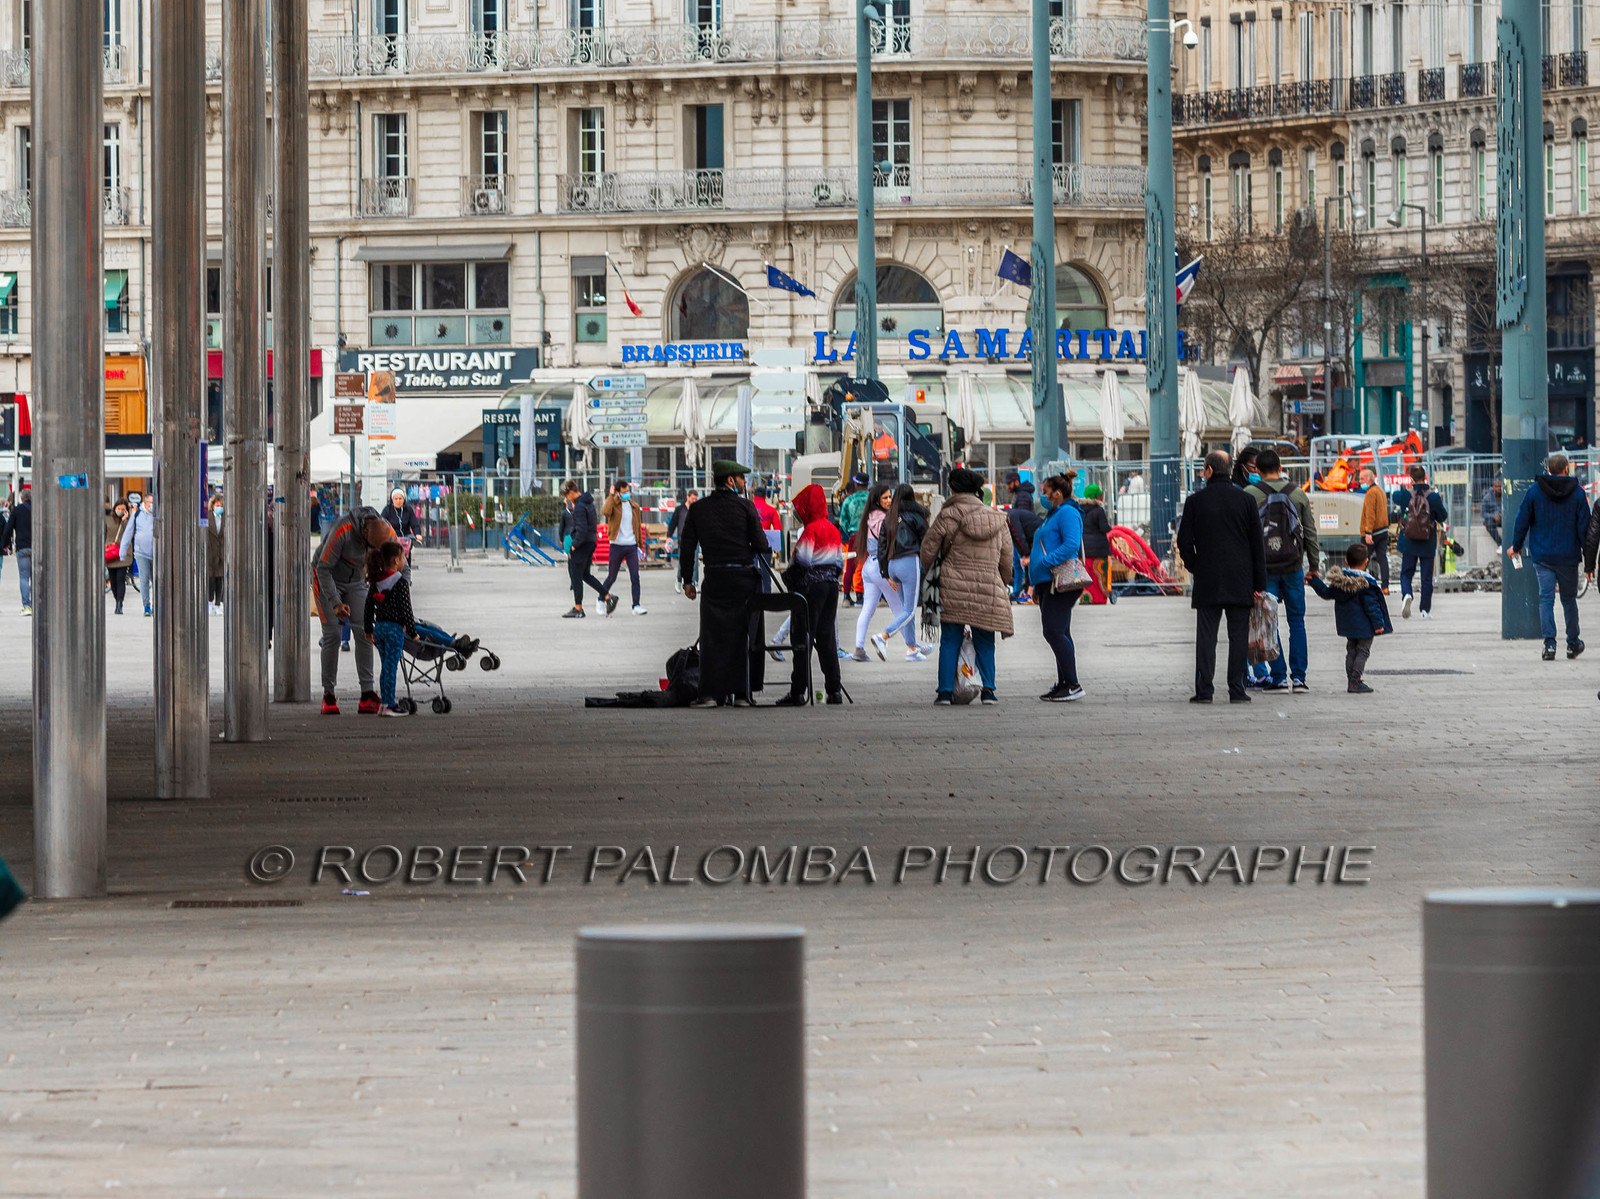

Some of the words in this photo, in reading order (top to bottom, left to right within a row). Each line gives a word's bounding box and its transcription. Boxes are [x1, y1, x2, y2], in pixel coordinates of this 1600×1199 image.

[621, 343, 744, 362] BRASSERIE
[908, 328, 1185, 361] SAMARITAIE
[357, 351, 516, 372] RESTAURANT
[404, 373, 447, 388] Table,
[449, 375, 470, 387] au
[471, 372, 503, 387] Sud
[483, 413, 556, 424] RESTAANT
